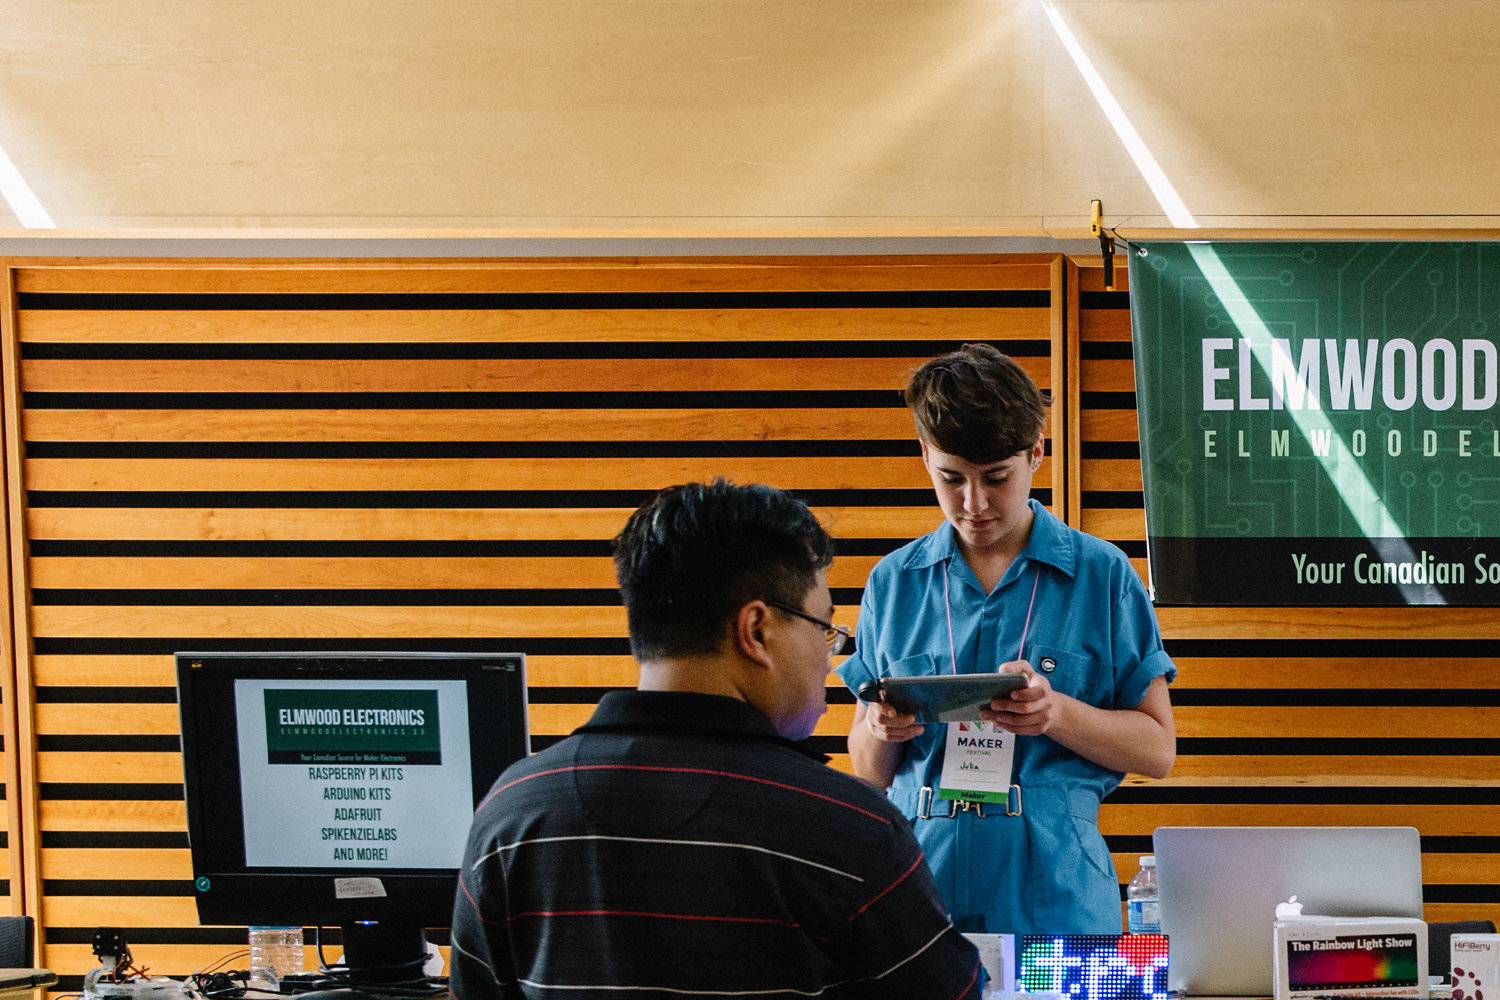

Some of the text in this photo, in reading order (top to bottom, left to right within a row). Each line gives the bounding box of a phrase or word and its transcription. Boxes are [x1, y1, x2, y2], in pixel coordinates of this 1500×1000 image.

[1201, 337, 1498, 411] ELMWOOD
[1292, 554, 1345, 584] Your
[1354, 551, 1465, 584] Canadian
[279, 709, 425, 726] ELMWOOD ELECTRONICS
[957, 737, 1003, 749] MAKER
[338, 754, 354, 762] Source
[364, 754, 379, 762] Maker
[380, 754, 407, 762] Electronics
[308, 767, 403, 780] RASPBERRY PI KITS
[323, 787, 391, 800] ARDUINO KITS
[334, 808, 382, 820] ADAFRUIT
[321, 828, 397, 841] SPIKENZIELABS
[334, 848, 388, 860] AND MORE!
[1292, 938, 1413, 951] The Rainbow Light Show
[1454, 942, 1491, 951] HiFiBerry
